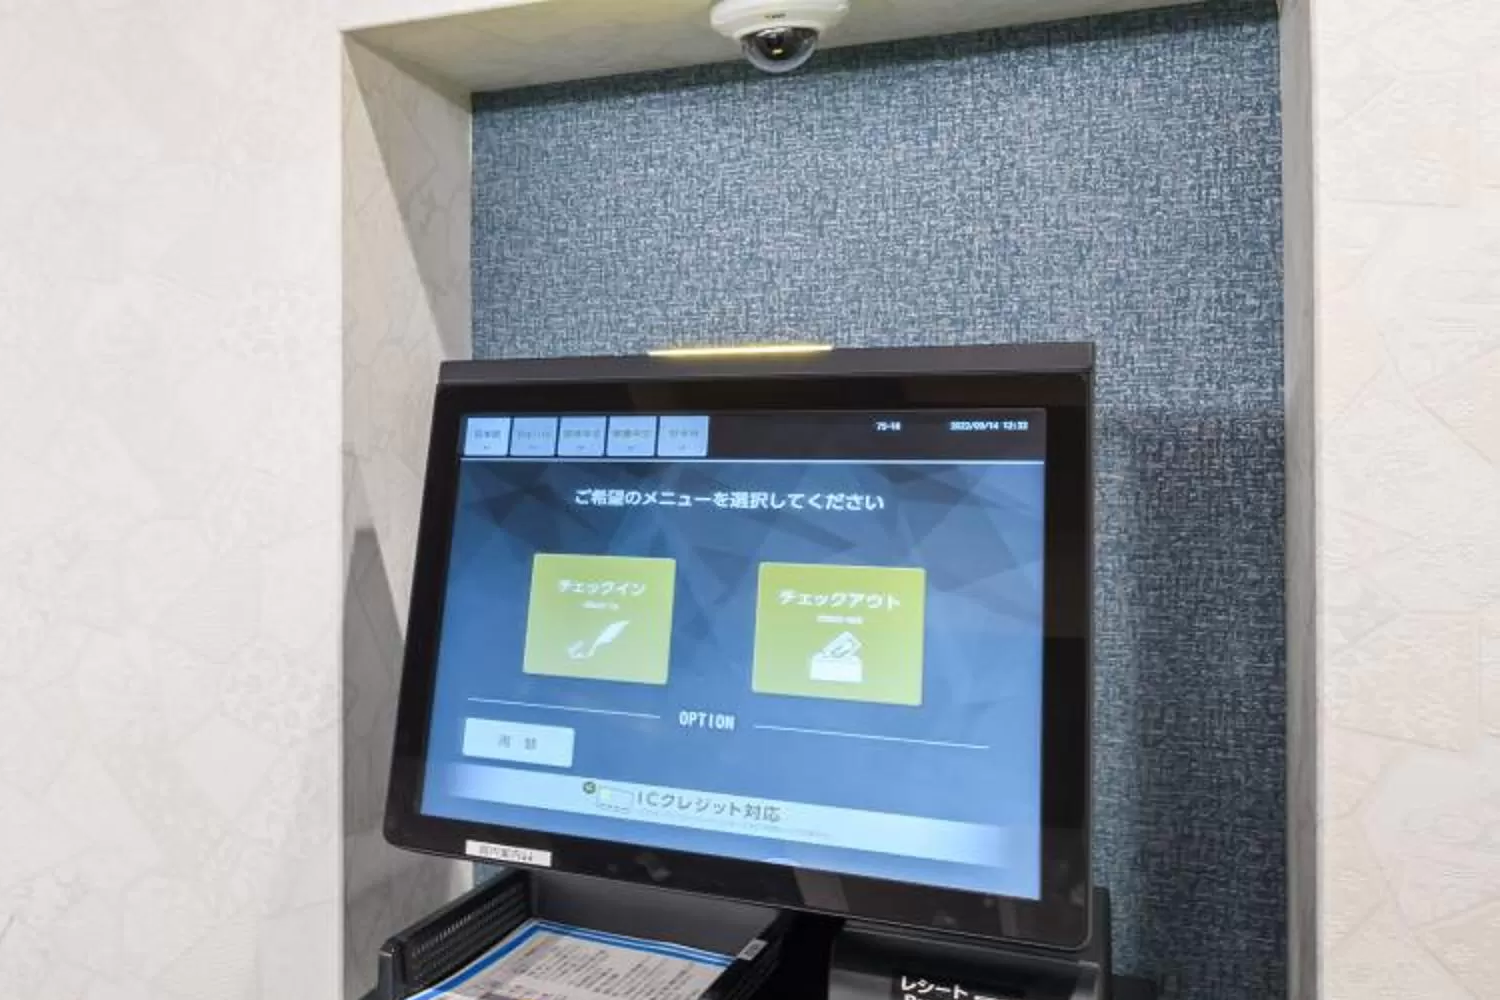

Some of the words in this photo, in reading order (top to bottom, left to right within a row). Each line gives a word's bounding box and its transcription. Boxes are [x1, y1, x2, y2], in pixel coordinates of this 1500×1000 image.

[574, 488, 885, 511] ご希望のメニューを選択してください
[557, 579, 646, 597] チェックイン
[778, 589, 901, 610] チェックアウト
[678, 711, 736, 731] OPTION
[637, 791, 781, 823] ICクレジット対応
[901, 976, 968, 999] レシート
